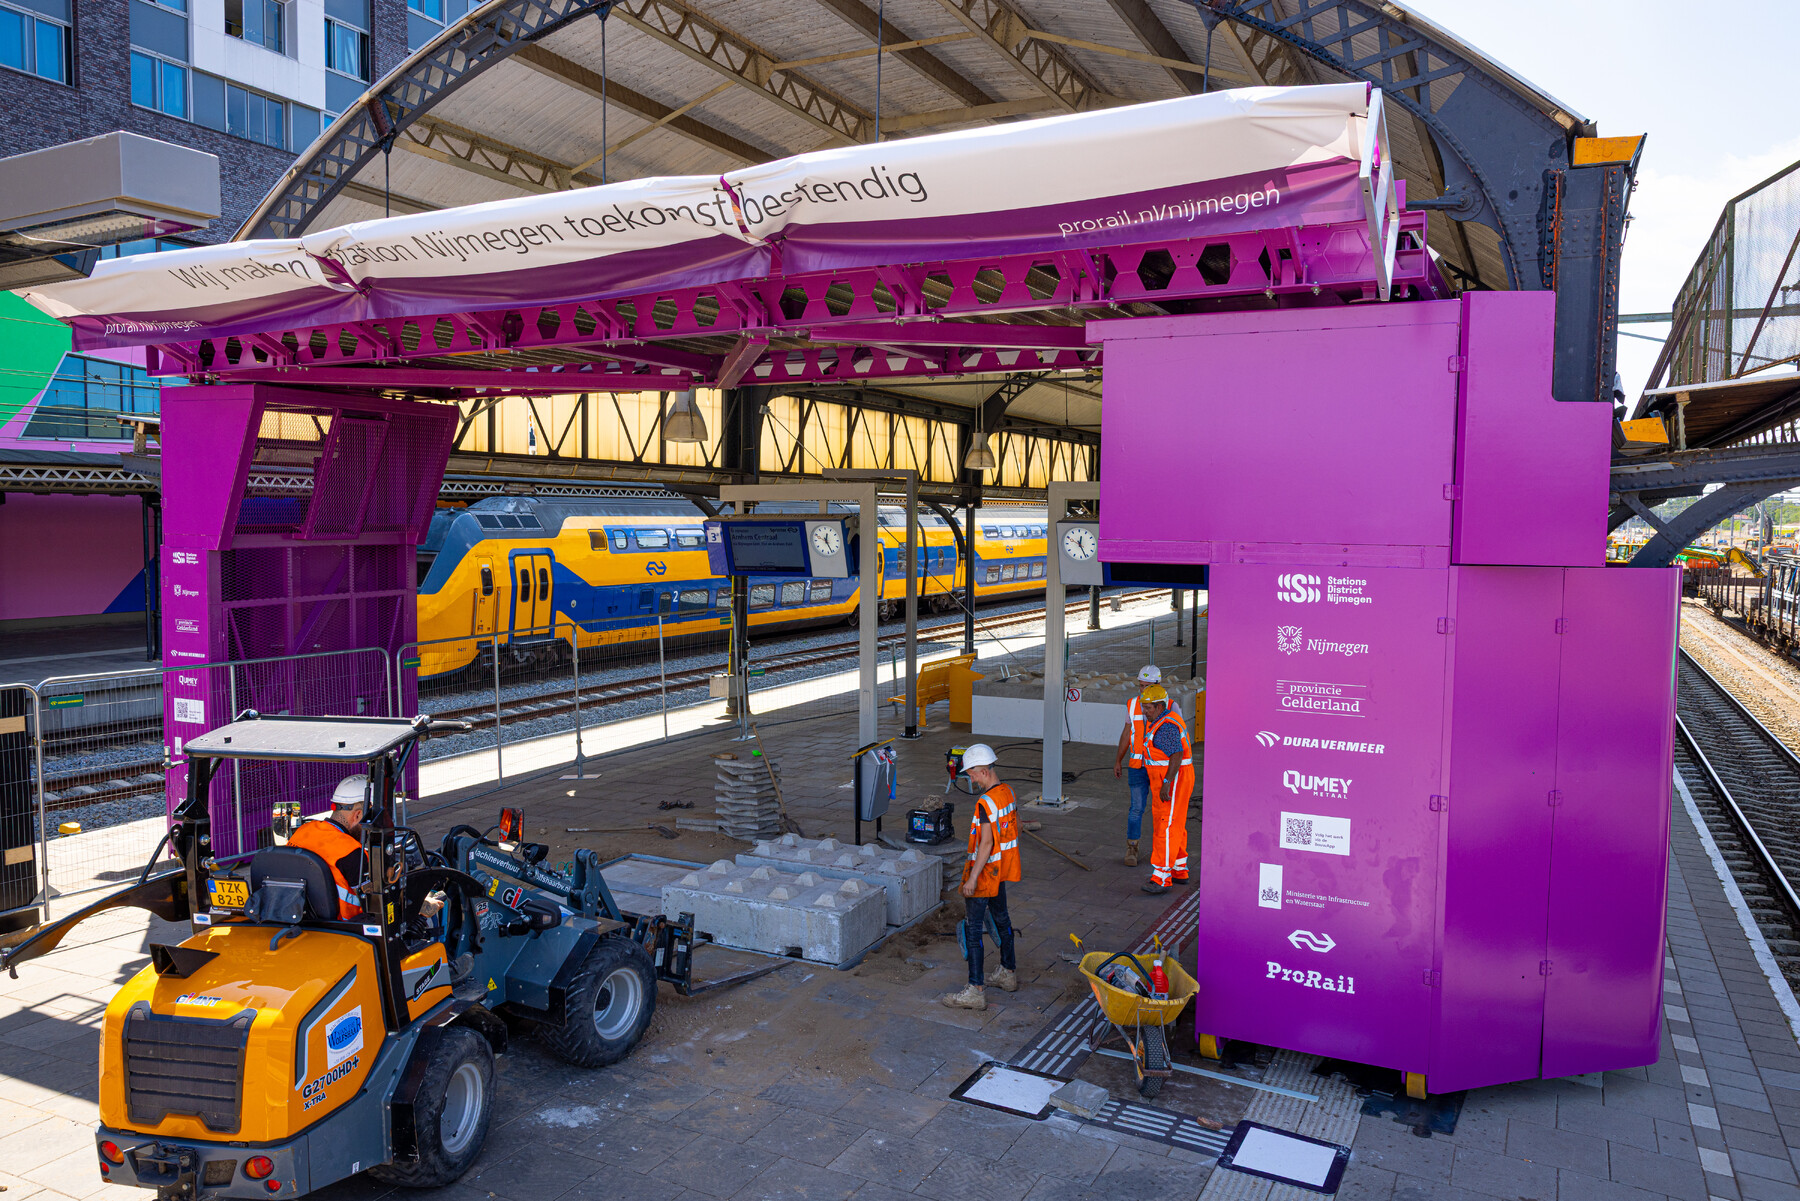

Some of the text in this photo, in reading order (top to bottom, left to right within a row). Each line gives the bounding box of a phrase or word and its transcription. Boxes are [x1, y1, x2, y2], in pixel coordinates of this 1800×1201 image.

[1058, 188, 1281, 238] prorail.nl/nijmegen
[168, 264, 230, 290] Wij
[411, 222, 565, 262] Nijmegen
[667, 528, 676, 539] 2
[806, 579, 811, 590] 2
[1327, 576, 1367, 586] Stations
[672, 590, 679, 603] 2
[1327, 585, 1363, 595] District
[1327, 594, 1373, 605] Nijmegen
[1306, 638, 1369, 657] Nijmegen
[1289, 683, 1342, 696] provincie
[1281, 696, 1360, 713] Gelderland
[1283, 736, 1386, 754] DURA VERMEER
[1283, 770, 1353, 794] QUMEY
[1313, 791, 1348, 800] METAAL
[218, 882, 243, 894] TZK
[217, 895, 245, 906] 82-B
[1286, 890, 1316, 899] Ministerie
[1328, 895, 1370, 907] Infrastructuur
[1294, 898, 1325, 908] Waterstaat
[1265, 961, 1356, 995] ProRail
[302, 1054, 360, 1099] G2700HD+
[303, 1091, 328, 1112] X-TRA
